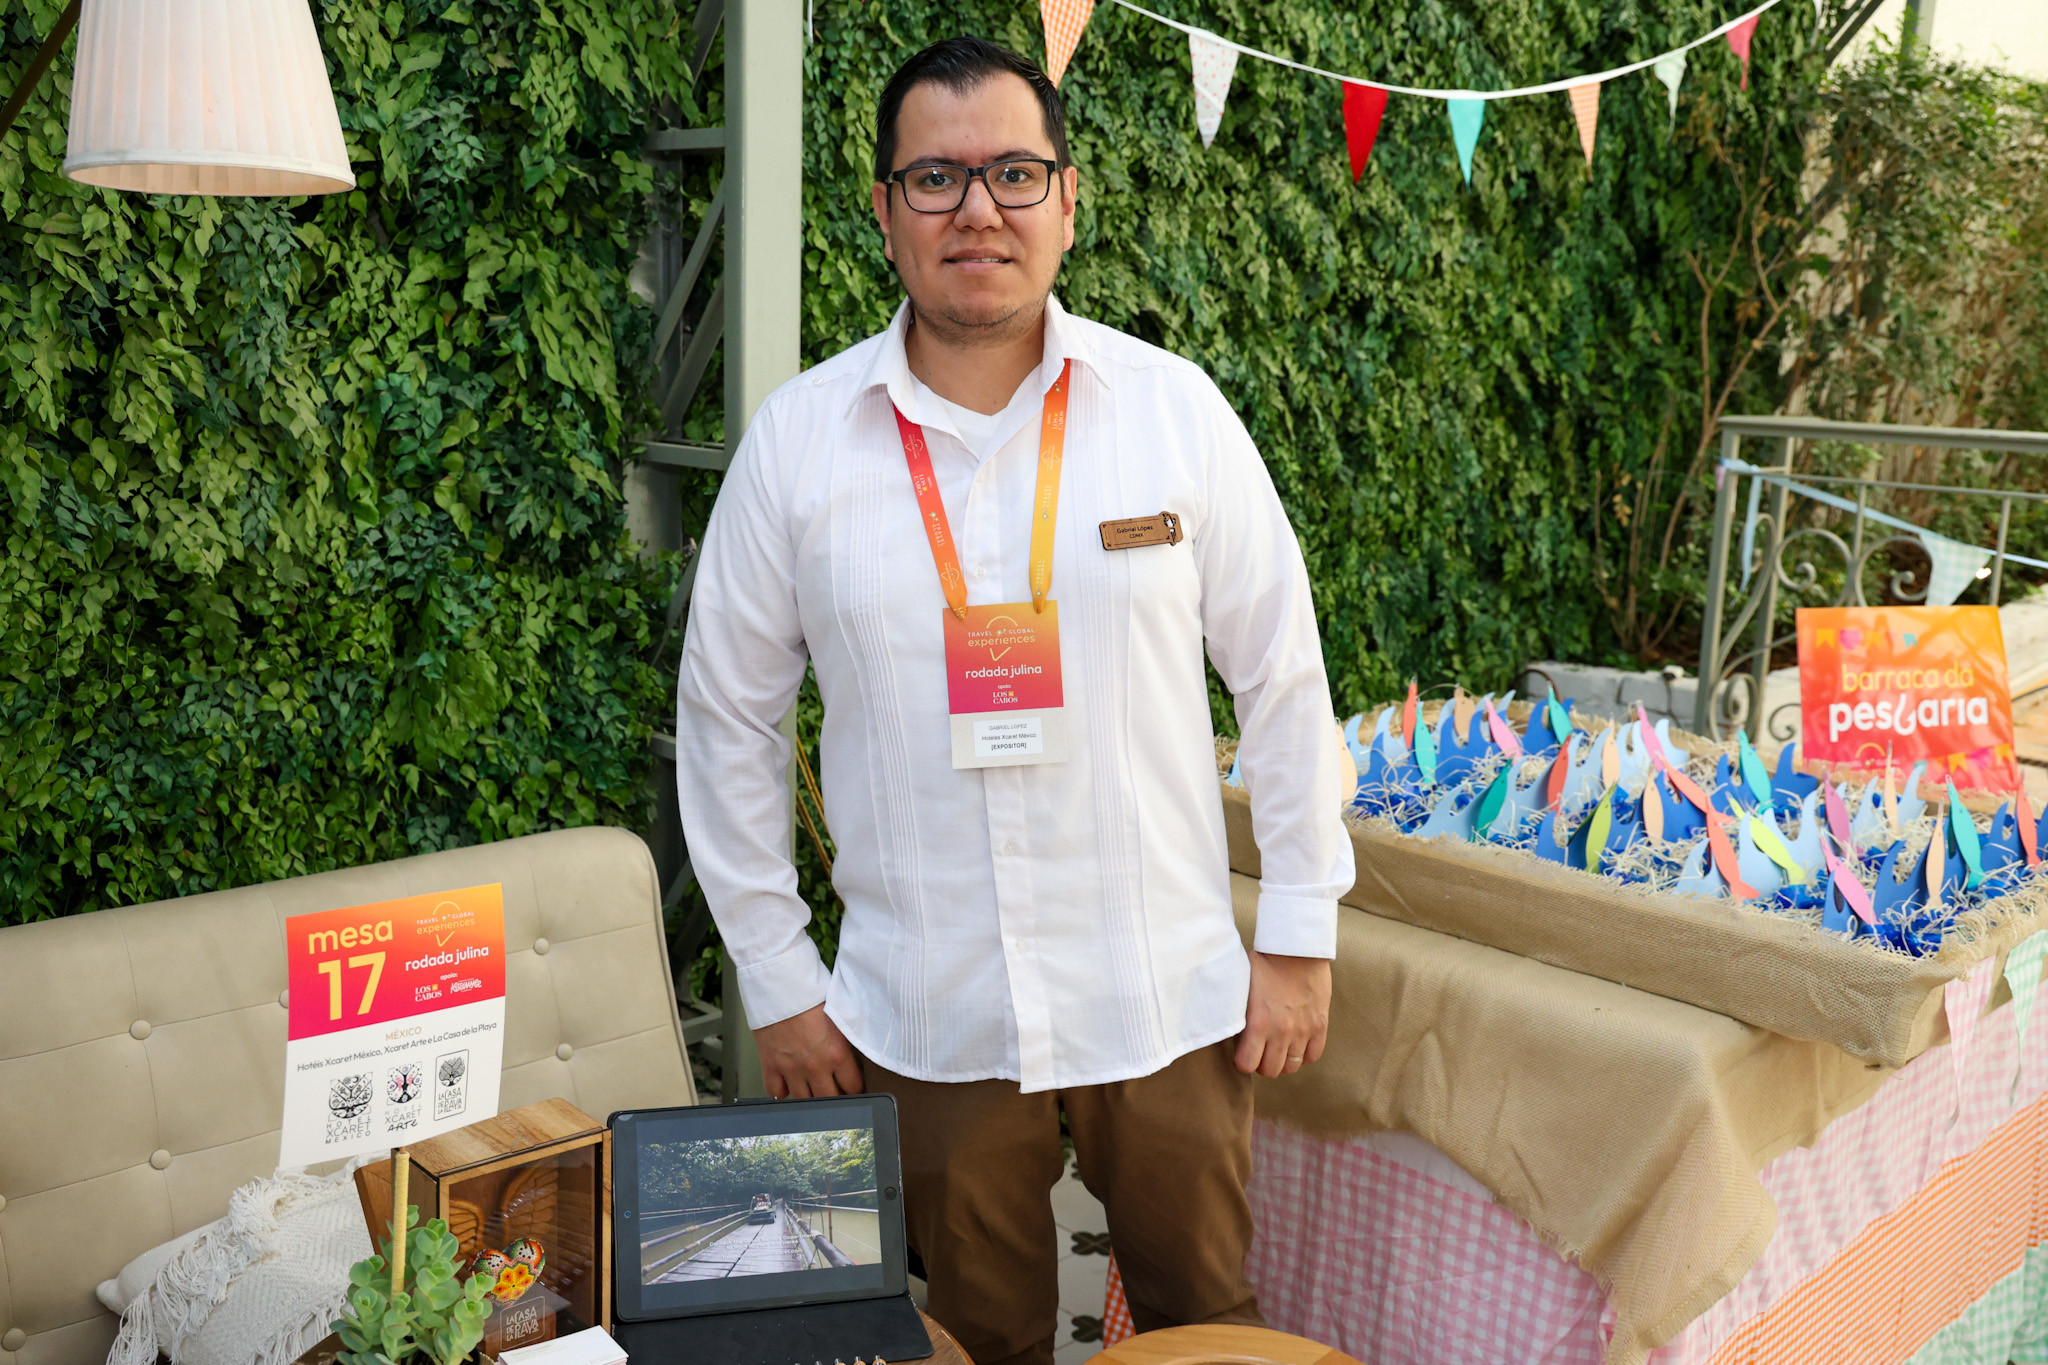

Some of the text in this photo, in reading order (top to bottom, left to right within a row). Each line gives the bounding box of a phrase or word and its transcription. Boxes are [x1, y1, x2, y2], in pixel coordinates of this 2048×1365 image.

[968, 635, 1036, 648] experiences
[965, 664, 1042, 679] rodada julina
[1841, 661, 1974, 692] barraca da
[991, 742, 1027, 750] [EXPOSITOR]
[416, 911, 475, 925] TRAVEL GLOBAL
[416, 918, 475, 935] experiences
[308, 920, 393, 954] mesa
[405, 946, 489, 971] rodada julina
[318, 951, 386, 1021] 17
[415, 985, 431, 994] LOS
[415, 990, 442, 1002] CABOS
[385, 1026, 422, 1041] MÉXICO
[297, 1060, 324, 1072] Hotéis
[325, 1055, 352, 1066] Xcaret
[353, 1049, 383, 1060] México,
[384, 1042, 409, 1054] Xcaret
[411, 1038, 426, 1048] Arte
[433, 1034, 442, 1043] La
[443, 1032, 461, 1040] Casa
[461, 1028, 470, 1036] de
[478, 1022, 497, 1032] Playa
[385, 1103, 421, 1116] HOTEL
[385, 1109, 421, 1124] XCARET
[326, 1116, 372, 1129] HOTEL
[326, 1121, 370, 1138] XCARET
[325, 1131, 371, 1144] MEXICO
[506, 1306, 537, 1326] LA CASA
[506, 1326, 514, 1334] DE
[506, 1334, 514, 1342] LA
